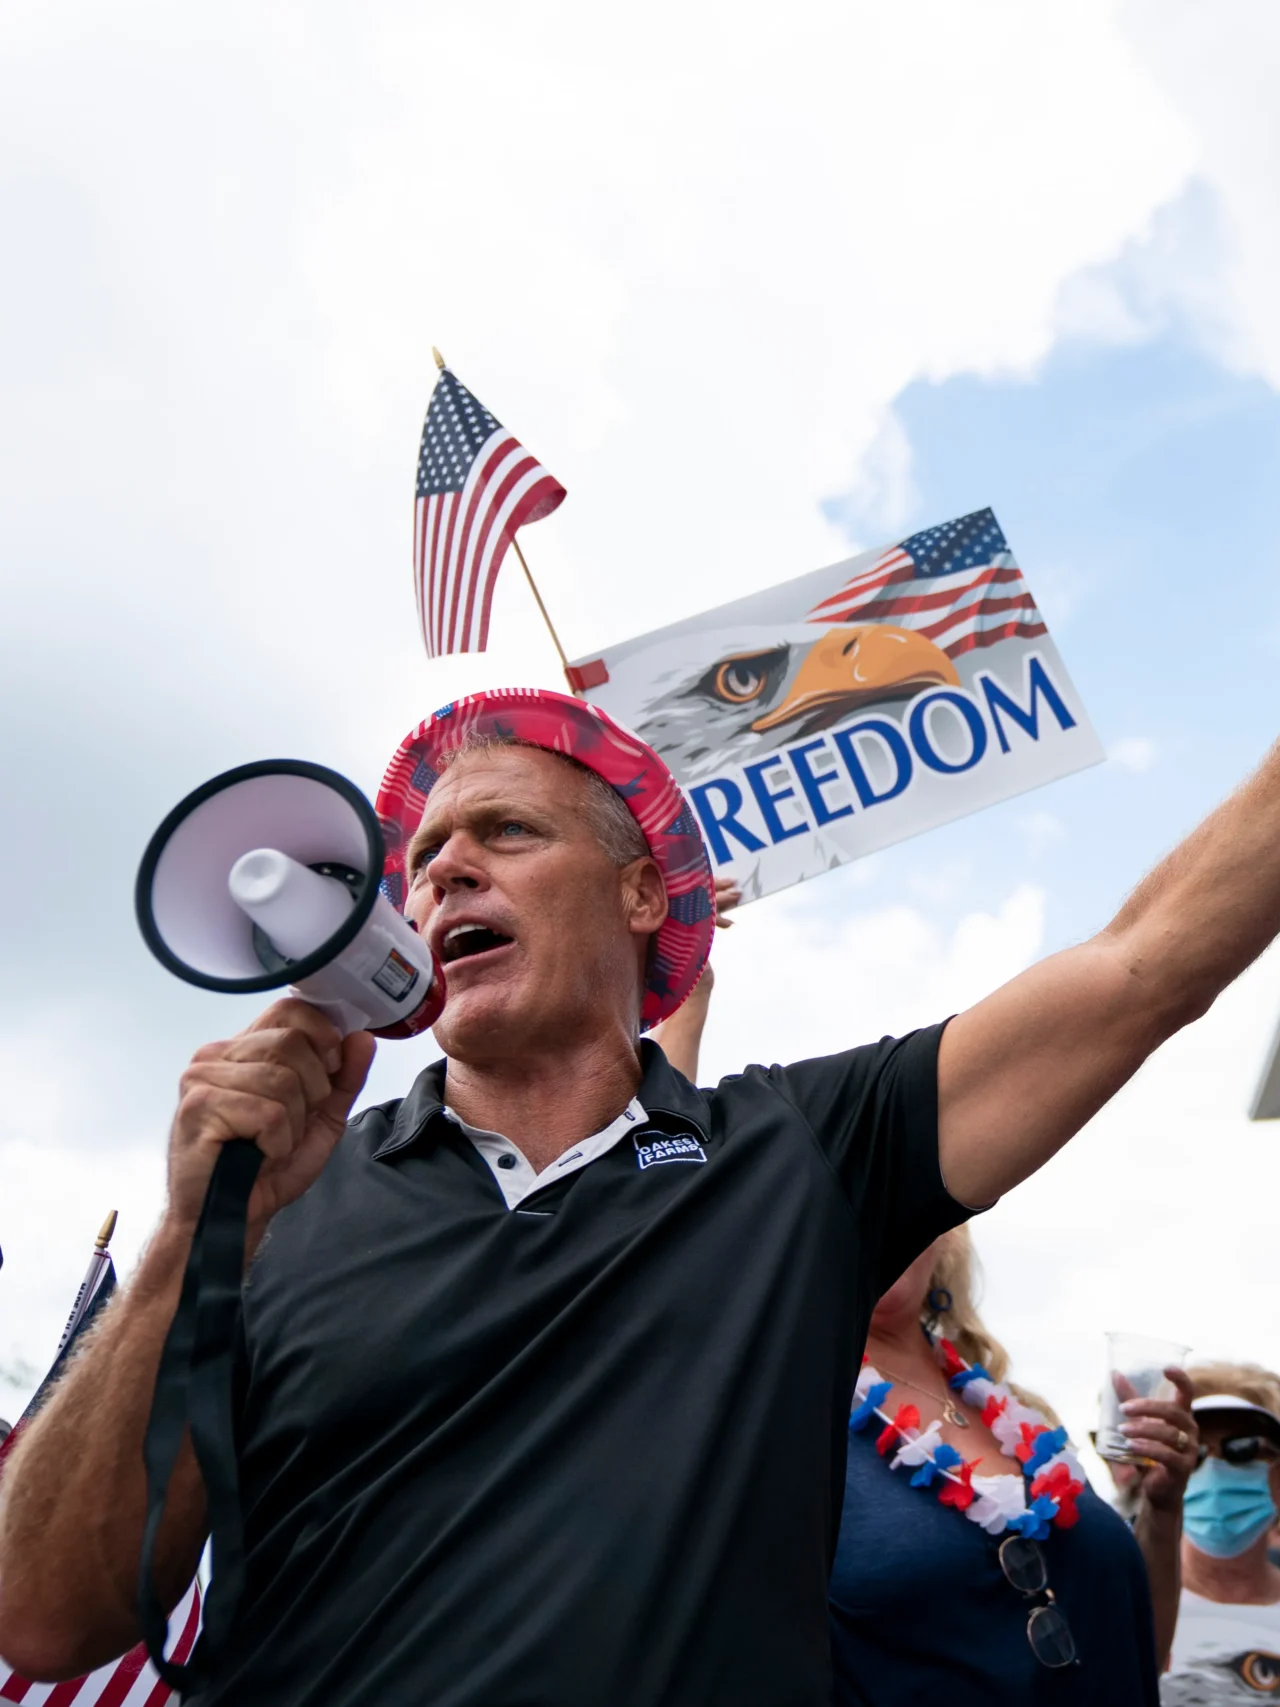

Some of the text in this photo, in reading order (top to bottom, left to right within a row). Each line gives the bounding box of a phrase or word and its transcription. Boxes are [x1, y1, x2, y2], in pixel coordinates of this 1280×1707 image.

[688, 656, 1077, 867] REEDOM
[639, 1137, 693, 1155] OAKES
[645, 1144, 701, 1163] FARMS
